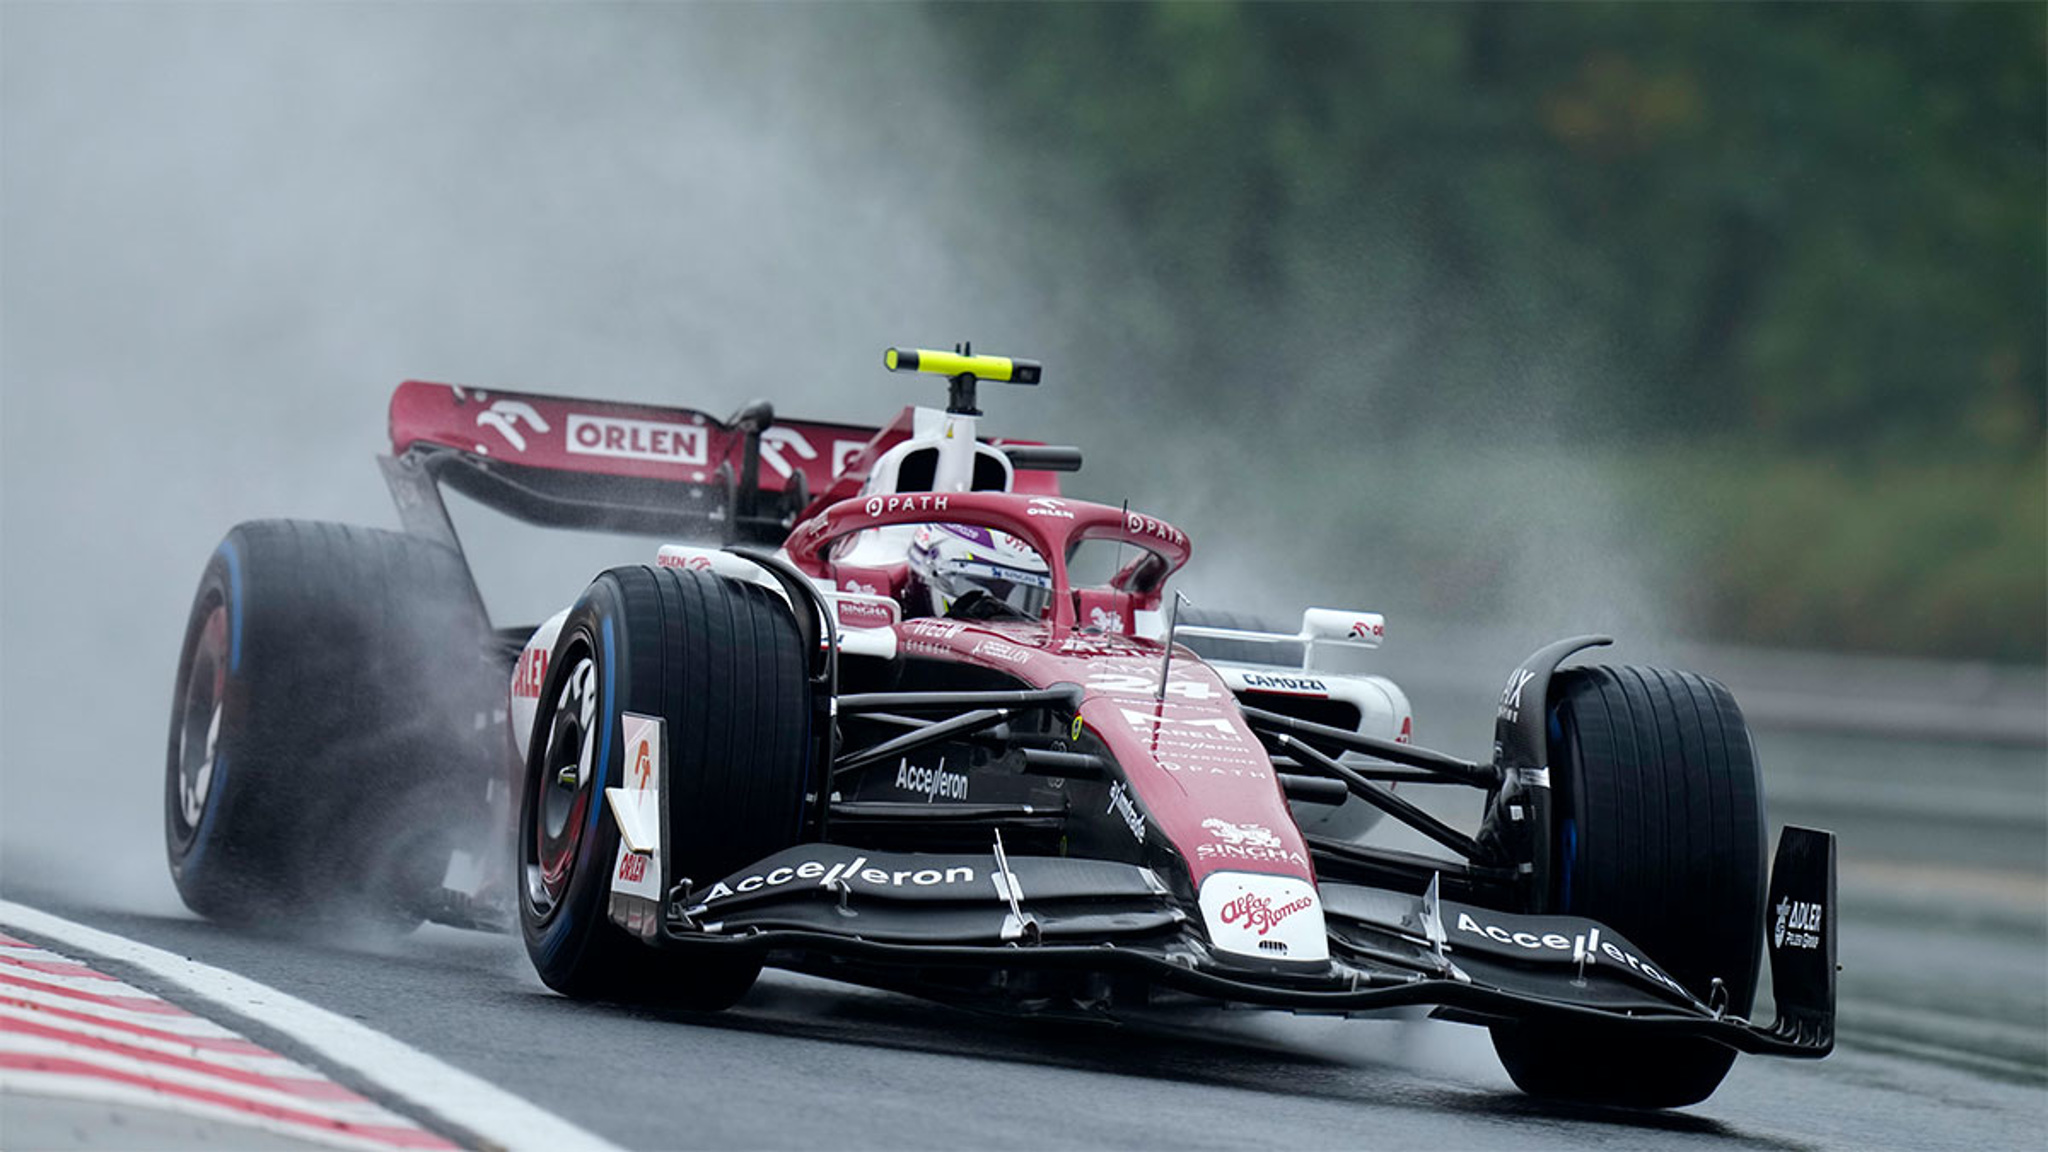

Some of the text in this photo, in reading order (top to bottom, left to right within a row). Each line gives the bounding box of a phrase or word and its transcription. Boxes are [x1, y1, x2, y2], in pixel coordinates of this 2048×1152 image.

[575, 422, 697, 458] ORLEN
[887, 496, 948, 512] PATH
[1146, 522, 1184, 546] PATH
[840, 603, 888, 617] SINGHA
[1084, 673, 1223, 700] 24
[1242, 673, 1328, 691] CAMOZZI
[895, 757, 969, 804] Accelleron
[618, 852, 647, 883] ORLEN
[1196, 844, 1306, 865] SINGHA
[701, 857, 975, 904] Accelleron
[1220, 892, 1312, 936] Alfa Romeo
[1788, 900, 1822, 932] ADLER
[1457, 912, 1689, 998] Accelleron
